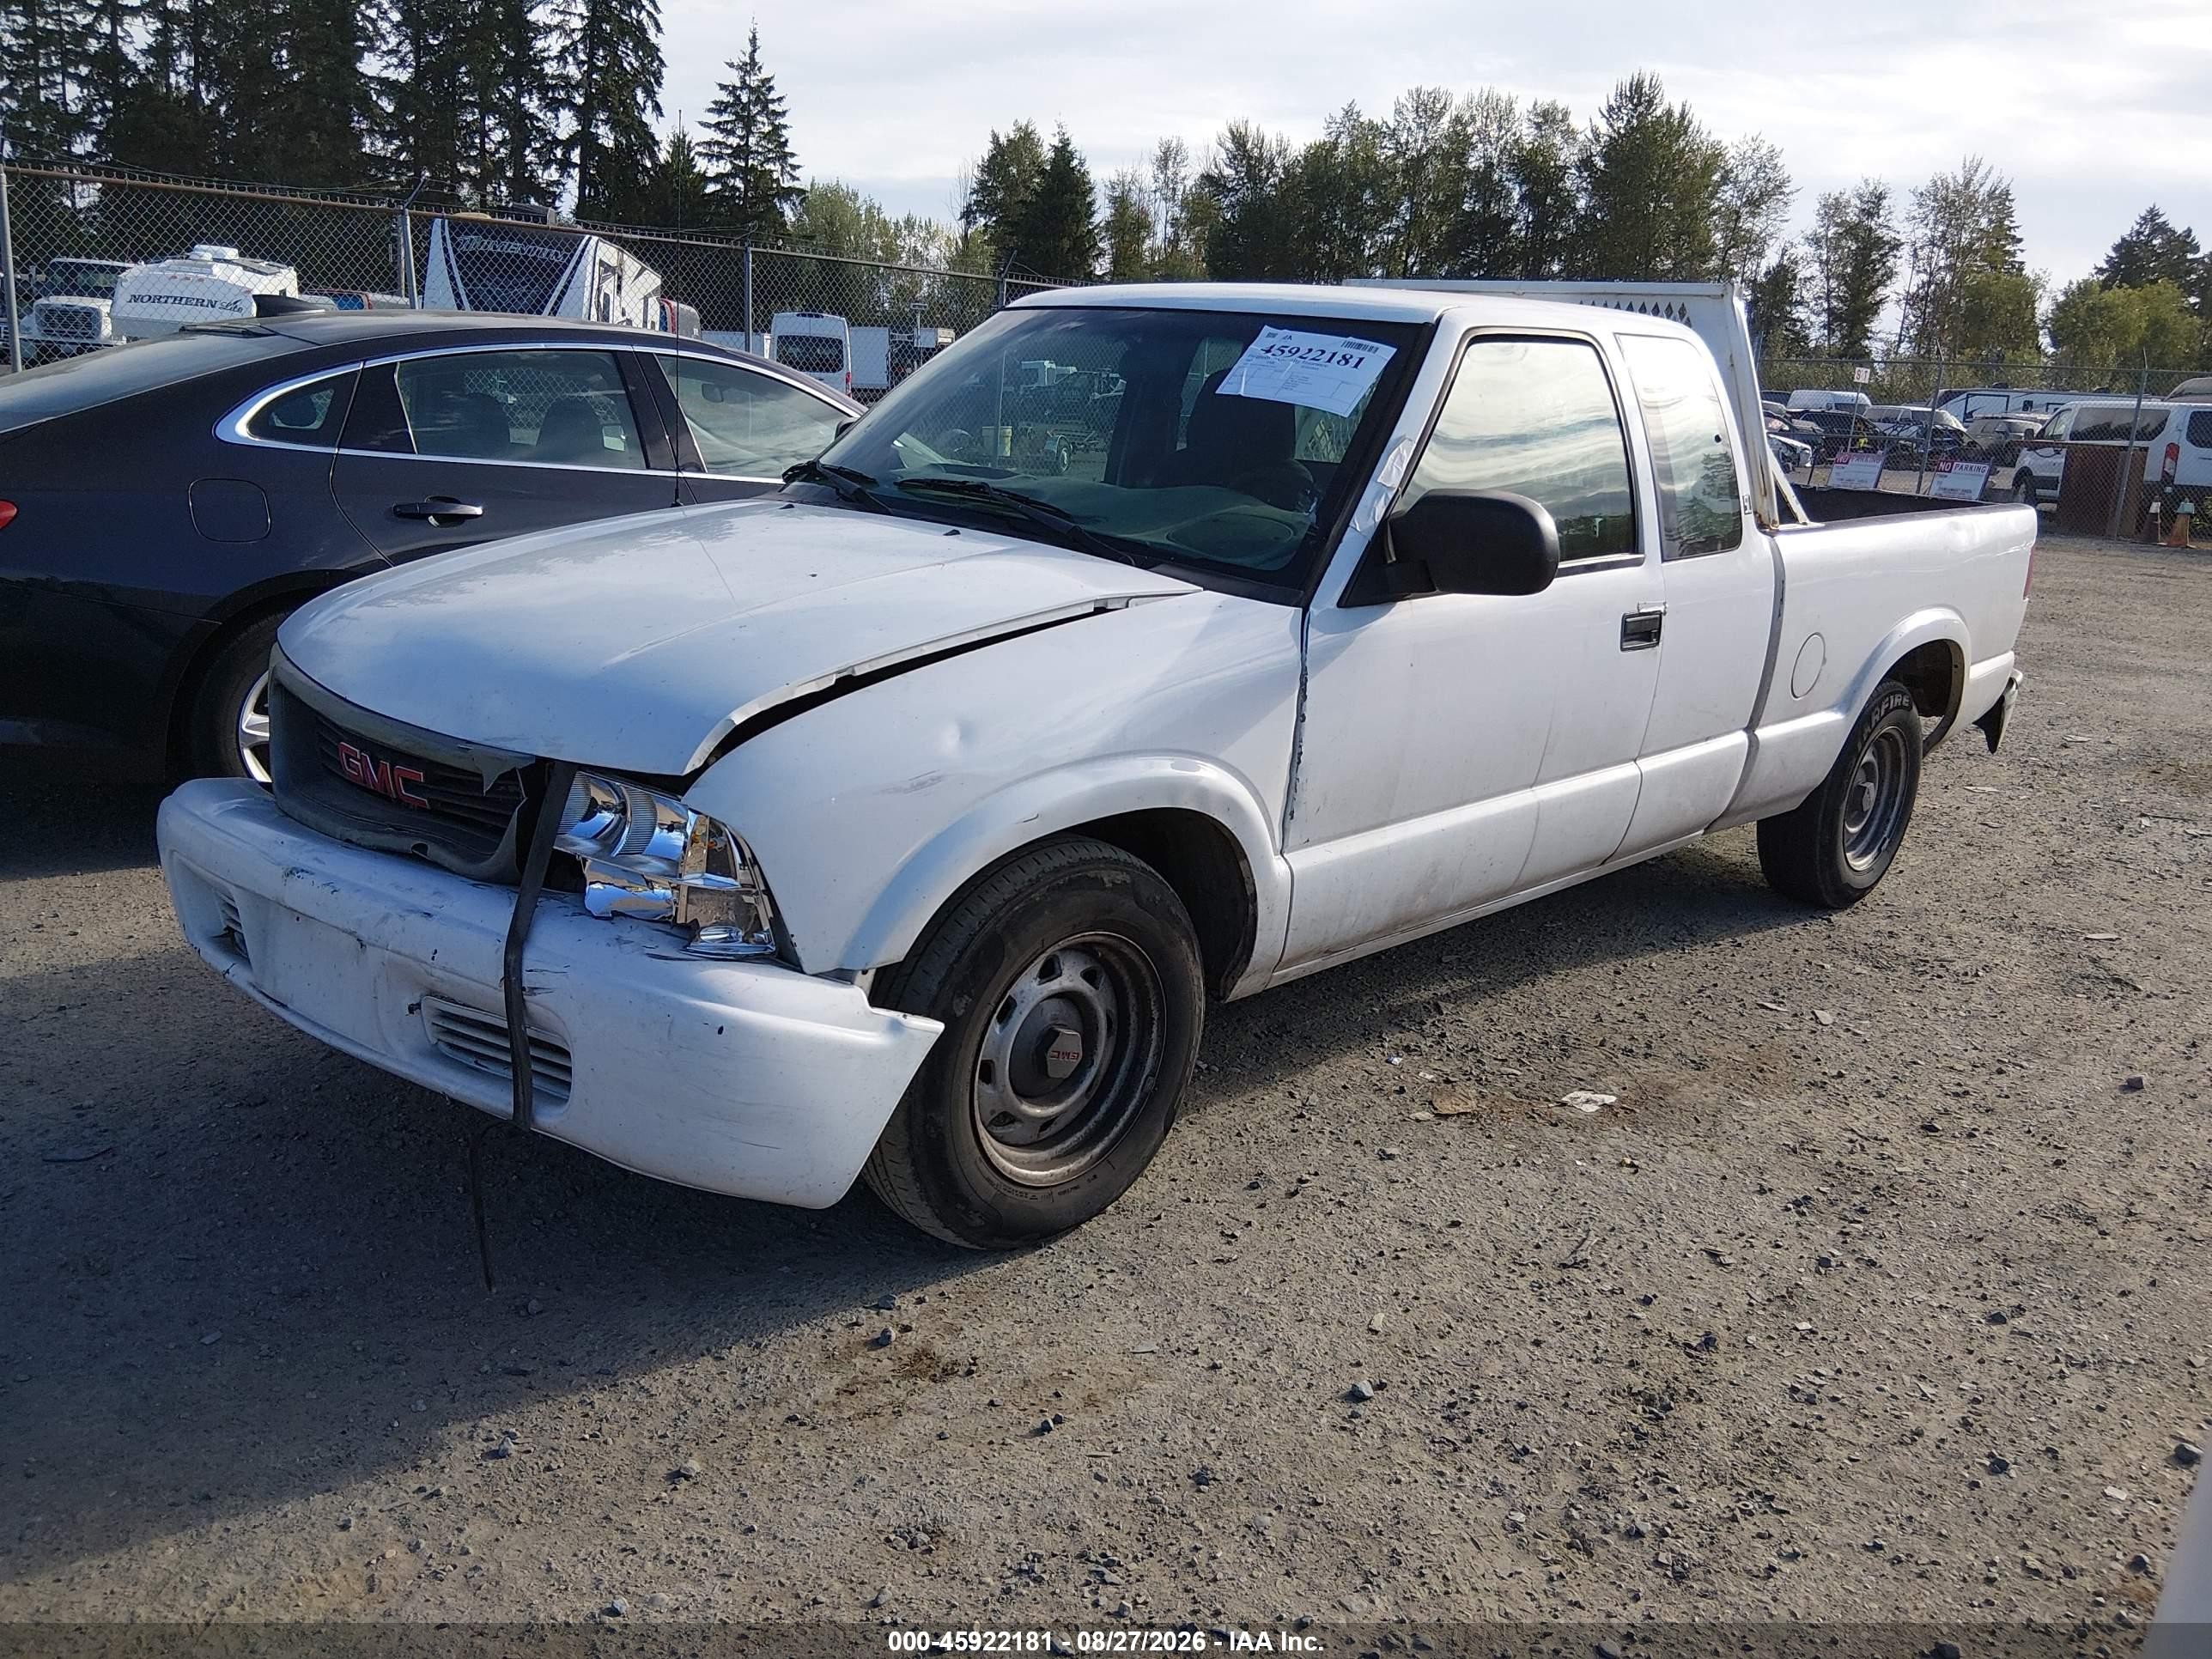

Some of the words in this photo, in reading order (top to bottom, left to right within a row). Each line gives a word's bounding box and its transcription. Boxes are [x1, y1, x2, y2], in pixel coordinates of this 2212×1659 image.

[127, 294, 217, 309] NORTHERN
[1261, 343, 1365, 369] 45922181
[1938, 461, 1952, 471] NO
[1954, 464, 1987, 474] PARKING
[337, 742, 431, 810] GMC
